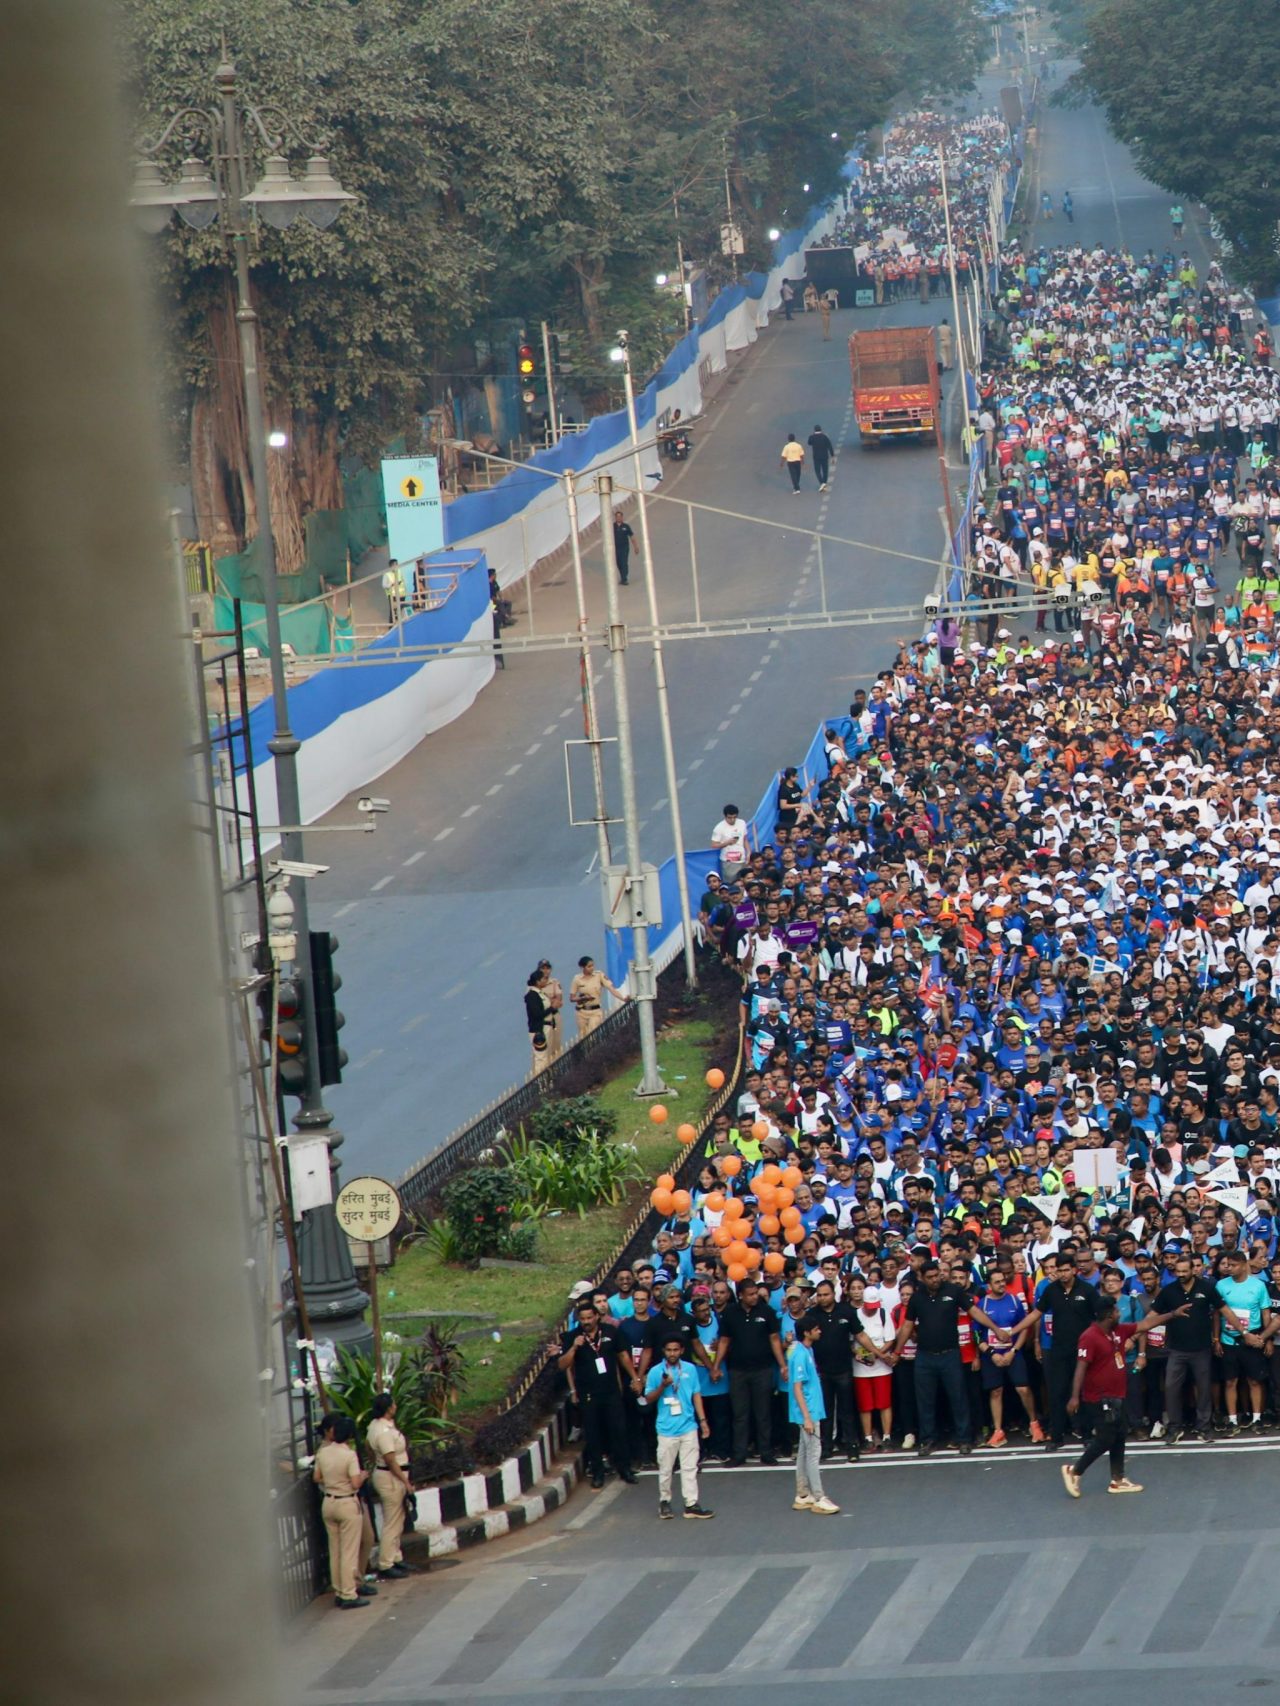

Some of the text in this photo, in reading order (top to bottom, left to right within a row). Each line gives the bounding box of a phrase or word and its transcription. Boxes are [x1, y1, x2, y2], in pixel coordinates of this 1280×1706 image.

[341, 1191, 365, 1205] हरित
[341, 1207, 391, 1225] सुंदर मुंबई
